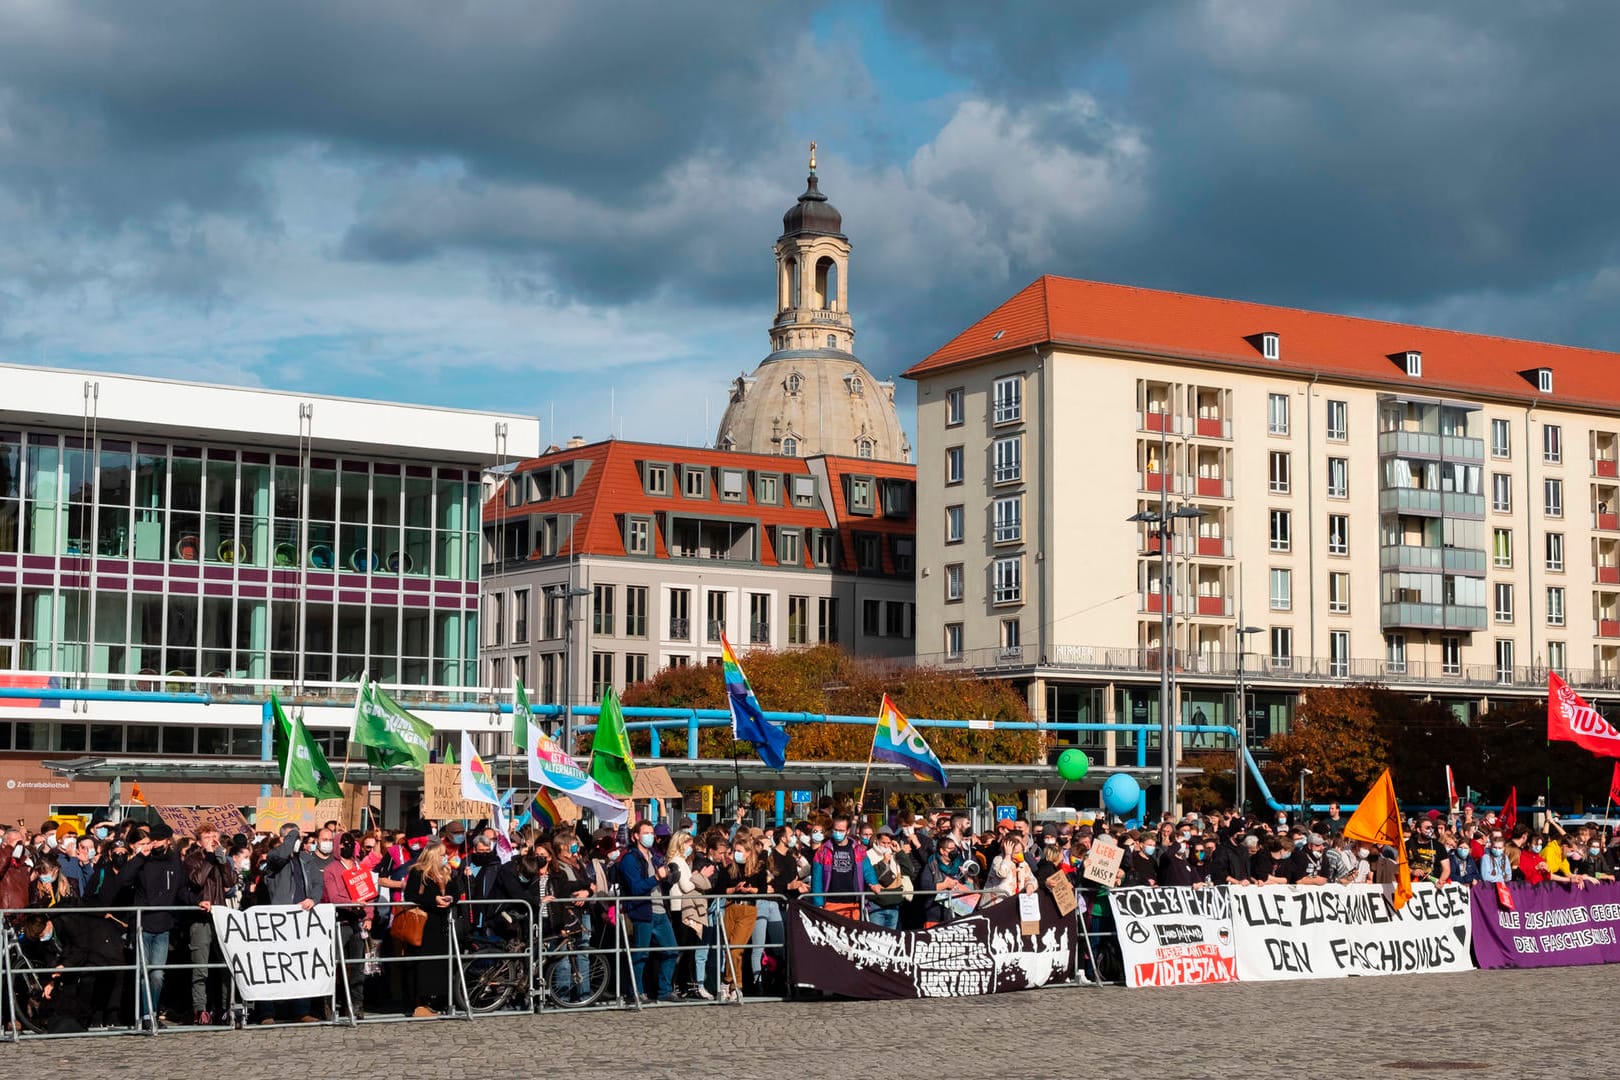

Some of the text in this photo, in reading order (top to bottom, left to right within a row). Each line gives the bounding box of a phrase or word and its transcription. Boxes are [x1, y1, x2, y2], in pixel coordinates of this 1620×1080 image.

[1056, 645, 1093, 656] HIRMER
[433, 768, 462, 785] NAZ
[206, 810, 240, 823] CLEAR
[207, 803, 235, 815] LOUD
[224, 909, 332, 943] ALERTA,
[913, 941, 994, 970] BORDERS
[1264, 938, 1314, 973] DEN
[1514, 936, 1539, 953] DEN
[233, 944, 334, 986] ALERTA!
[920, 971, 992, 998] HISTORY
